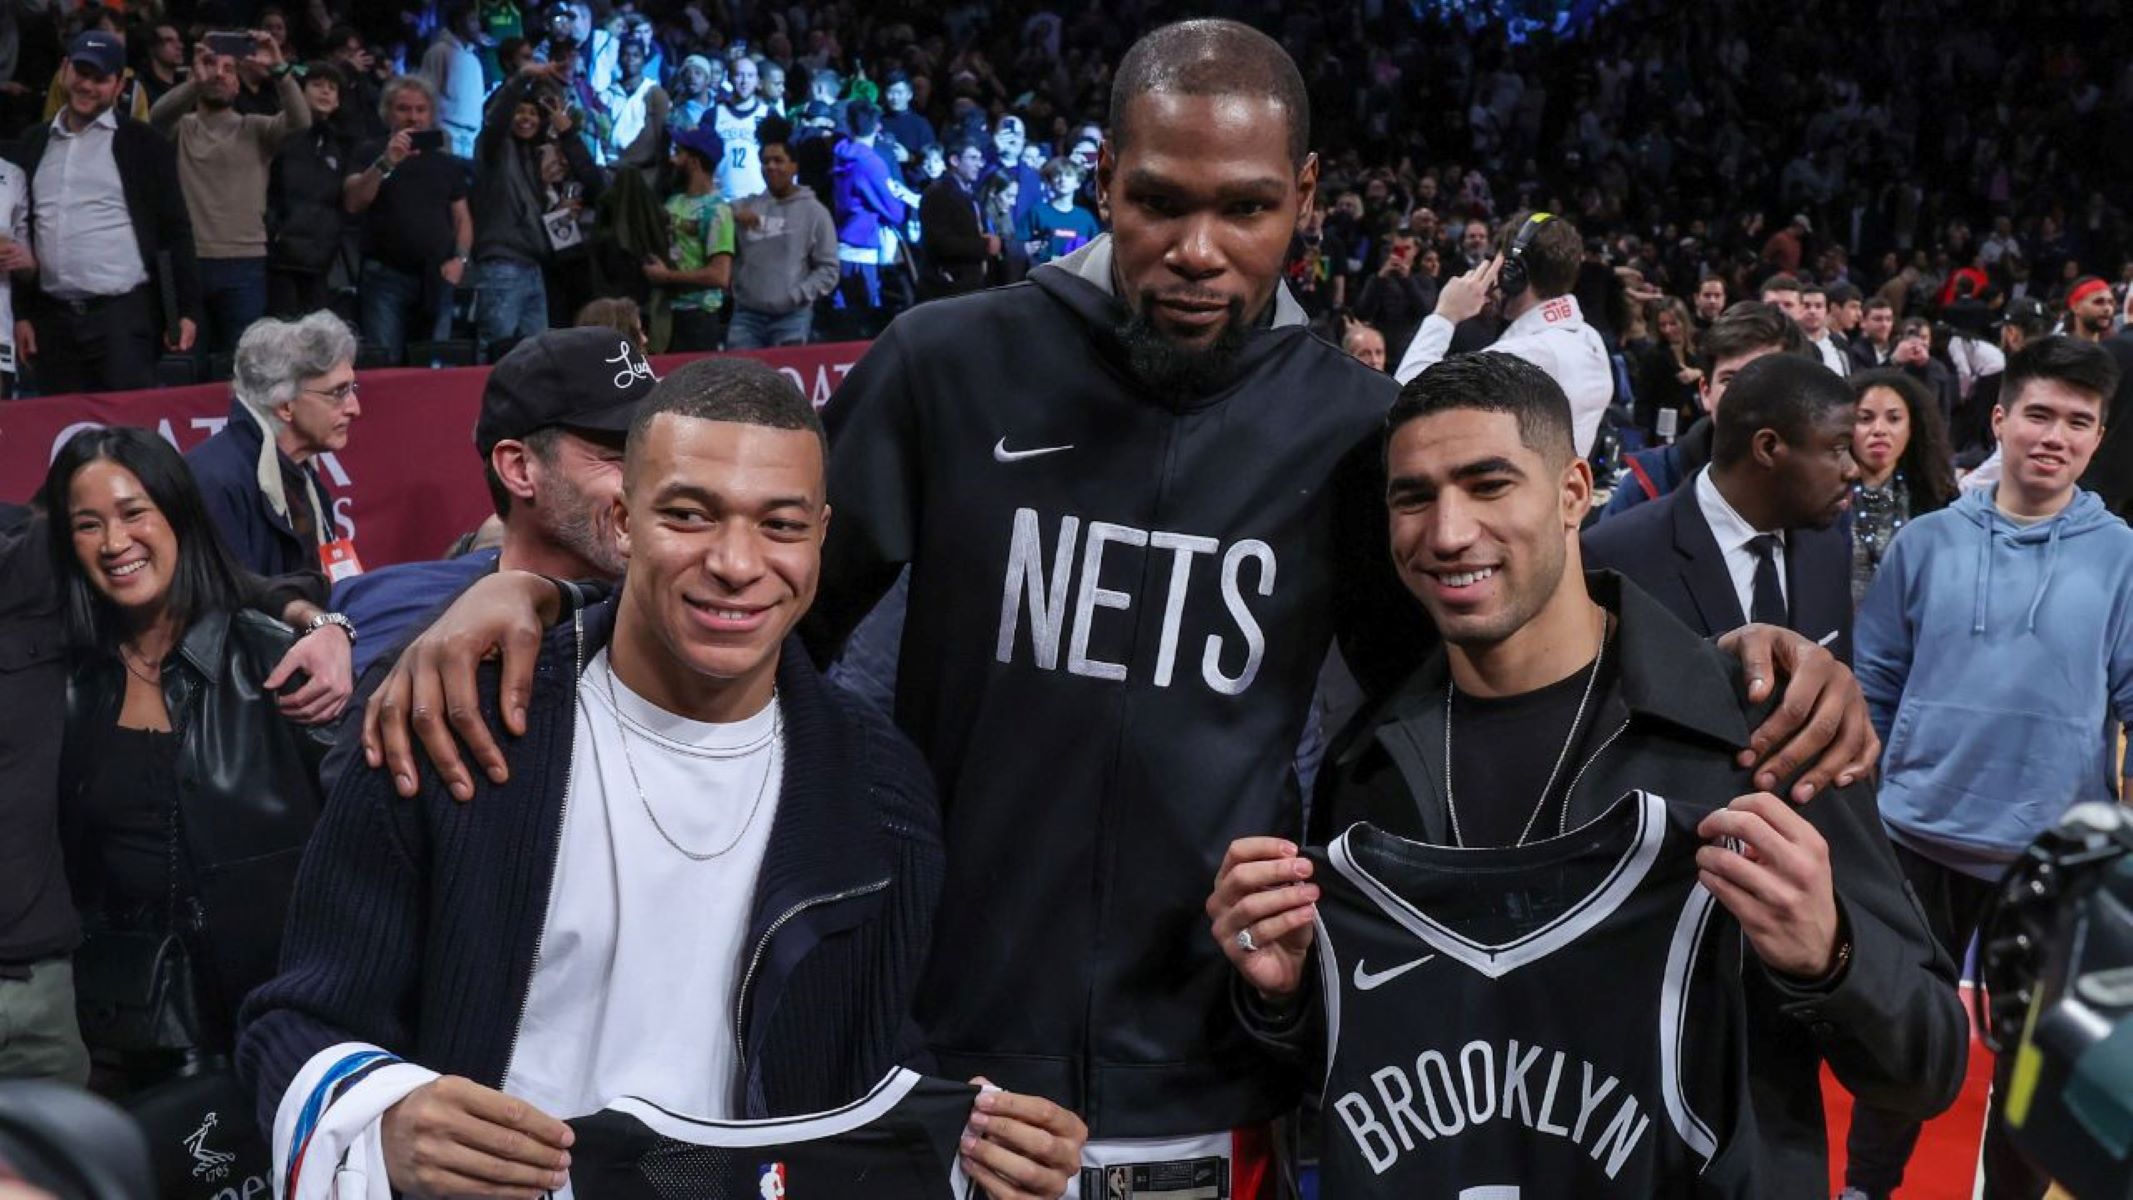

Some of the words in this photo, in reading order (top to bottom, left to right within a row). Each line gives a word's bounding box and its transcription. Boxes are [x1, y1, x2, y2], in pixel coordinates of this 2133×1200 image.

[732, 147, 747, 168] 12
[997, 507, 1277, 696] NETS
[1334, 1039, 1650, 1181] BROOKLYN
